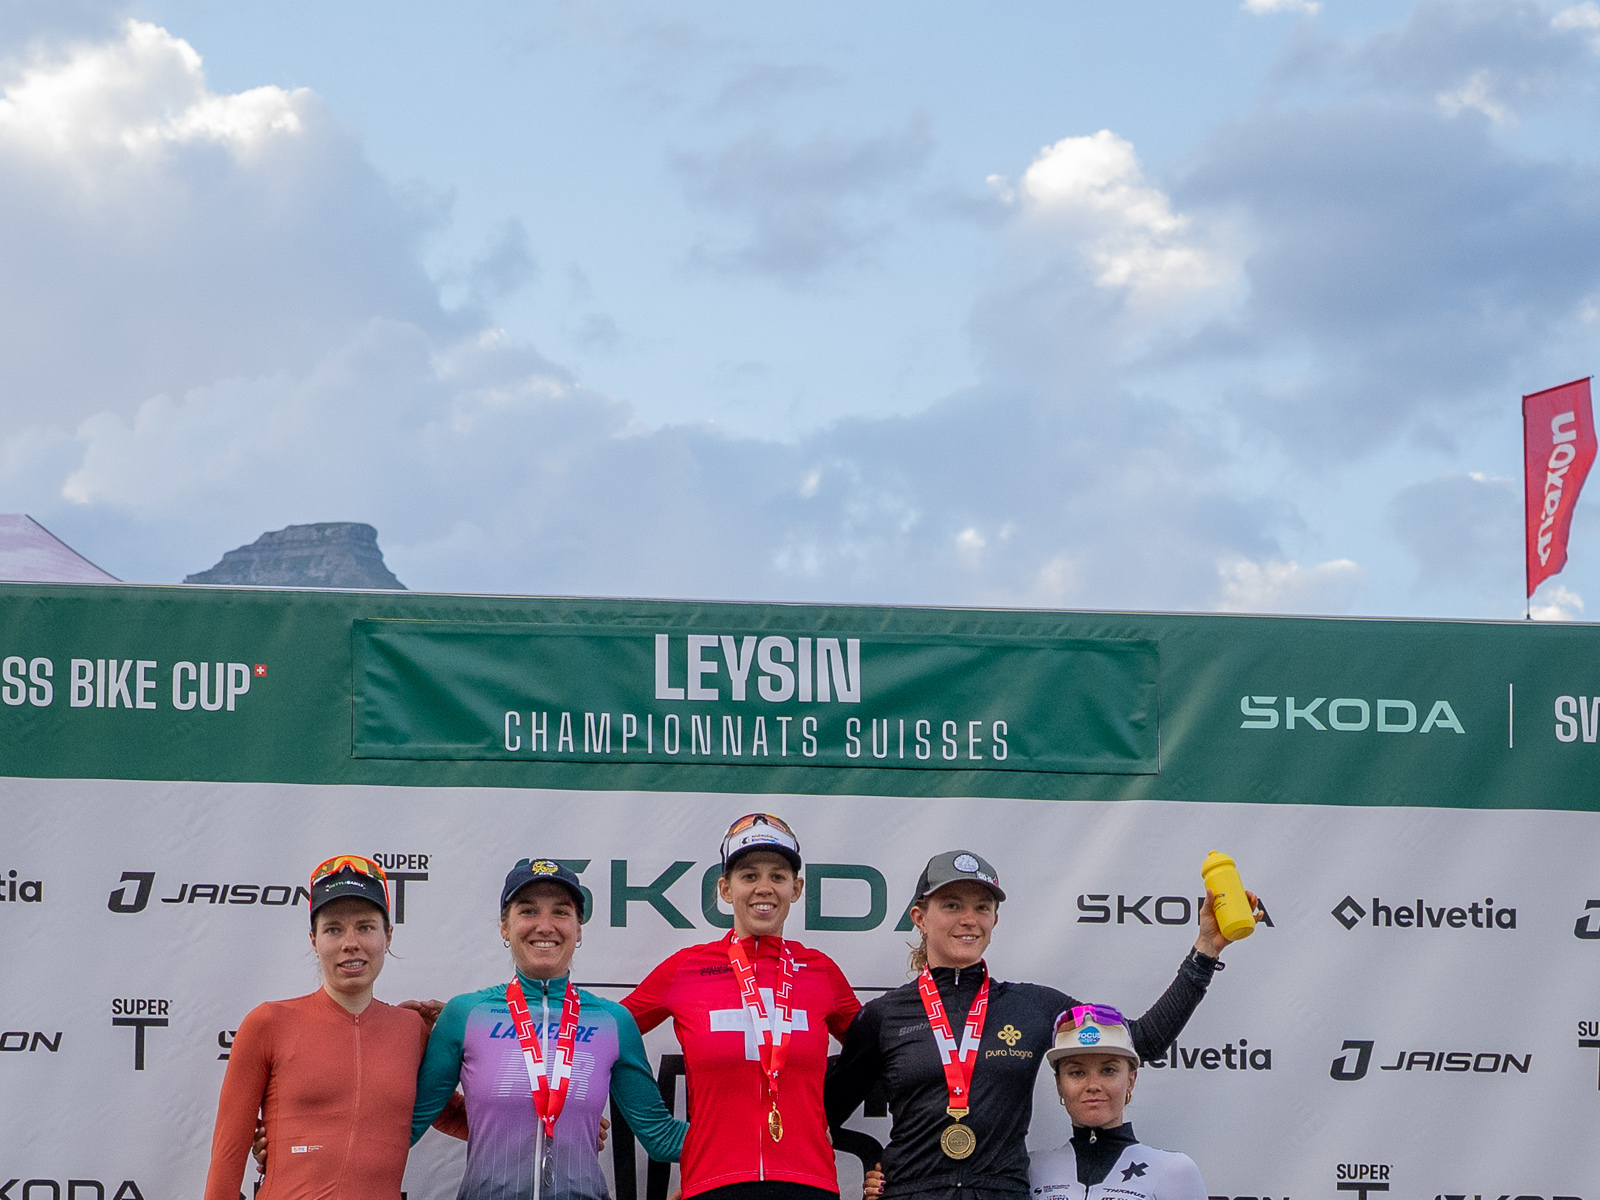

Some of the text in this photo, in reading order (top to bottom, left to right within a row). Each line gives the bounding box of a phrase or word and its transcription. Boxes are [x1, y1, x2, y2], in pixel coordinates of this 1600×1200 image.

[1537, 411, 1577, 567] maxon
[655, 634, 860, 703] LEYSIN
[1, 656, 251, 712] SS BIKE CUP
[504, 710, 1009, 761] CHAMPIONNATS SUISSES
[373, 853, 428, 870] SUPER
[1373, 898, 1517, 930] helvetia
[112, 998, 168, 1016] SUPER
[0, 1031, 63, 1052] ON
[1380, 1051, 1533, 1074] JAISON
[1336, 1163, 1390, 1181] SUPER
